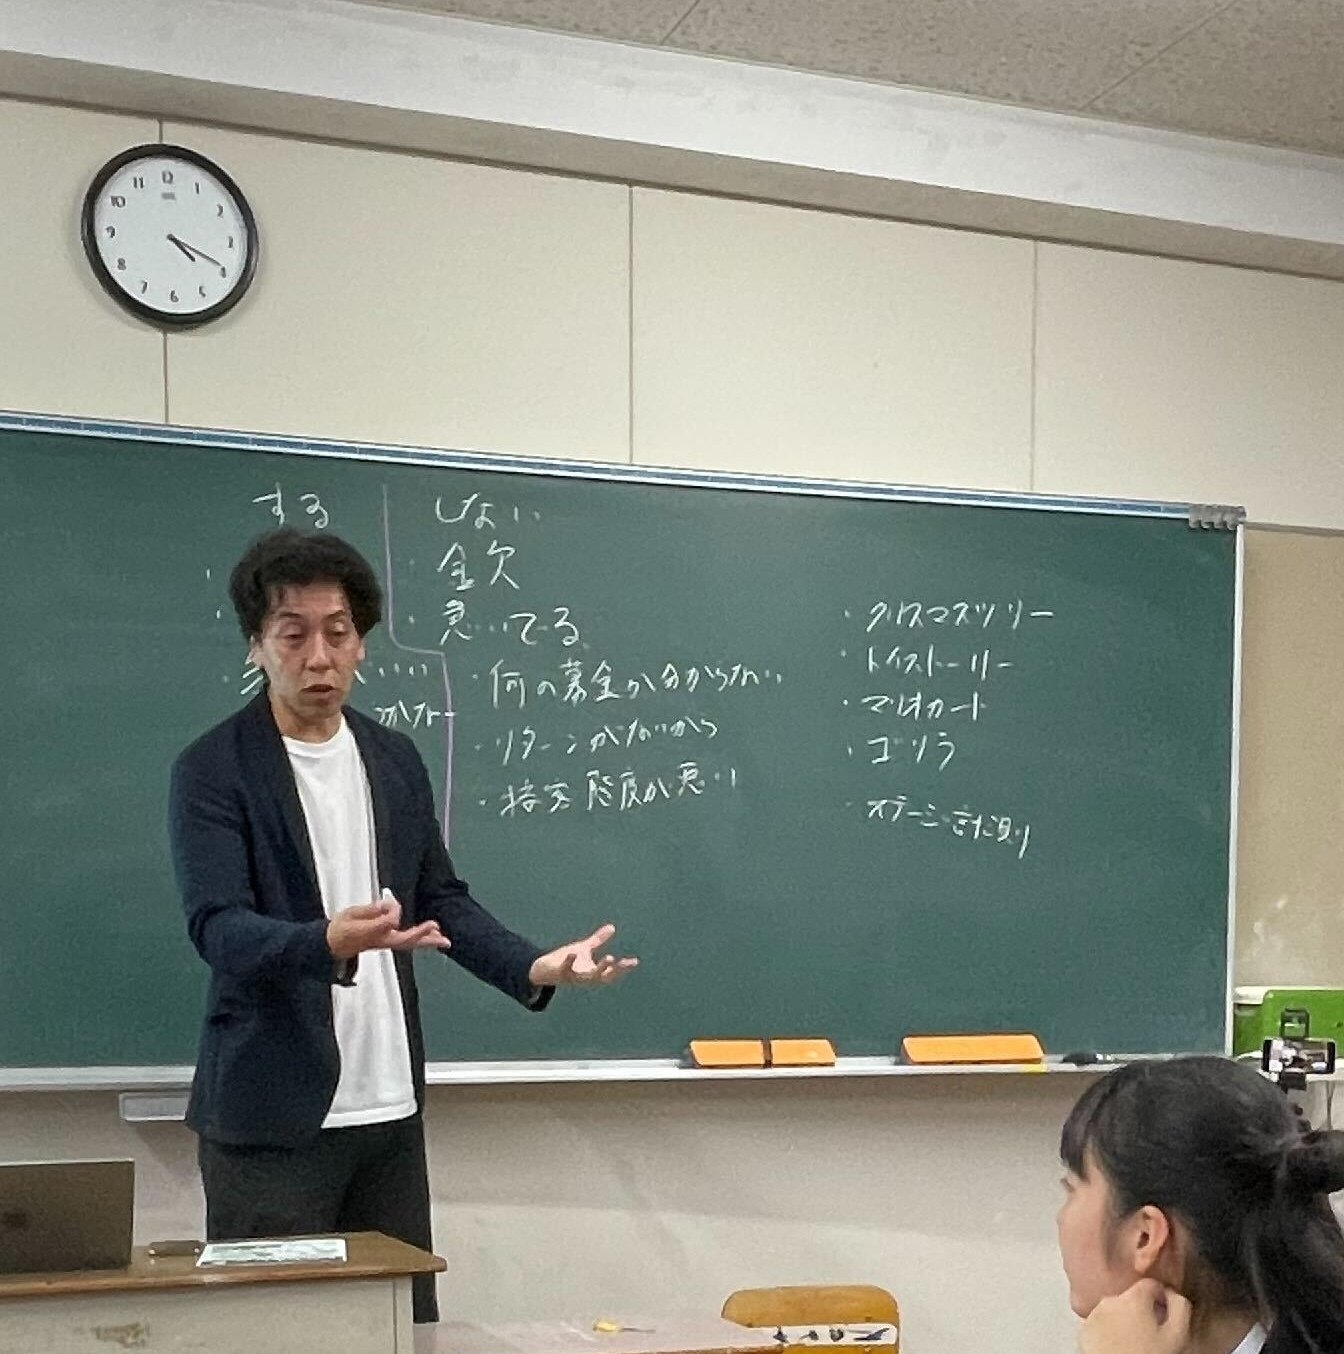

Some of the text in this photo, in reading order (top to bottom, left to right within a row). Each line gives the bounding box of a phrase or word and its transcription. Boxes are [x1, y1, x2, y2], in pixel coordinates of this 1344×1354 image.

[133, 177, 145, 189] 11
[169, 290, 179, 303] 6
[252, 481, 331, 529] する
[435, 491, 541, 530] しない
[436, 539, 520, 592] 金欠
